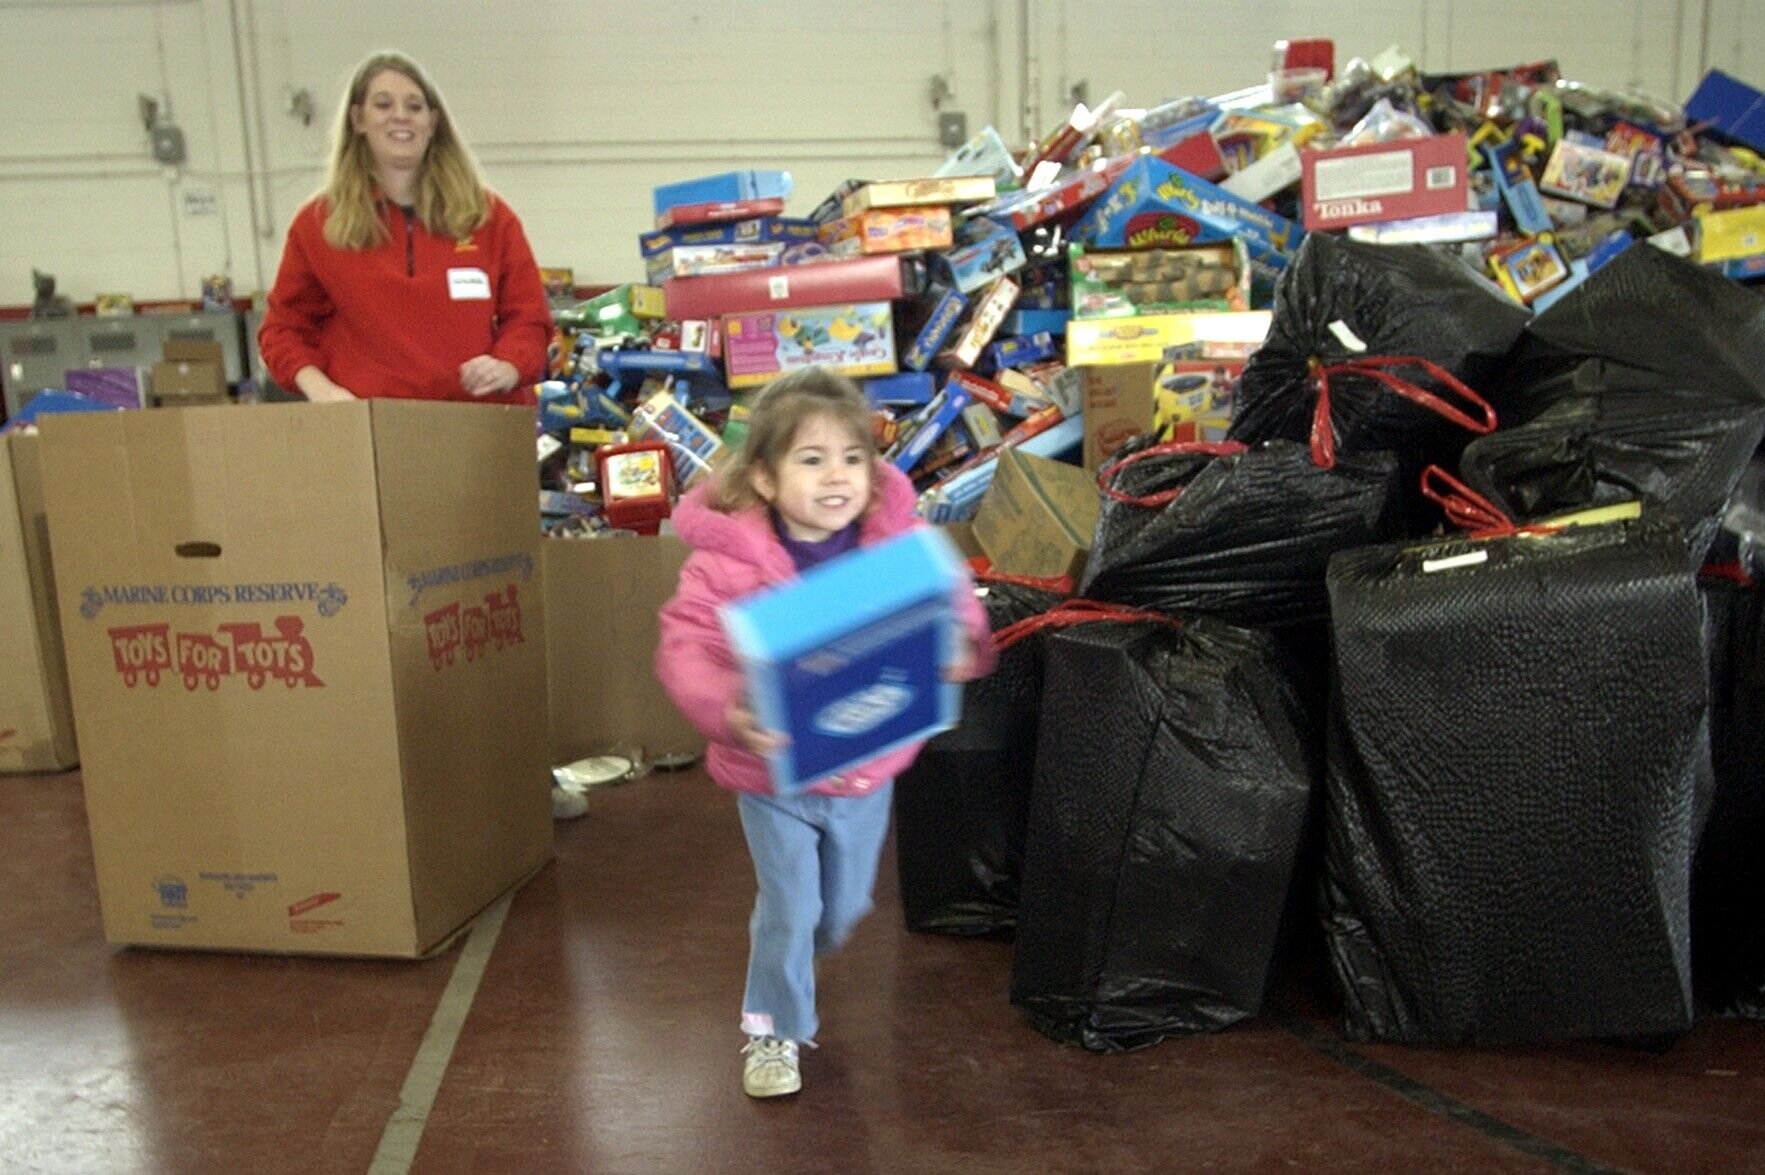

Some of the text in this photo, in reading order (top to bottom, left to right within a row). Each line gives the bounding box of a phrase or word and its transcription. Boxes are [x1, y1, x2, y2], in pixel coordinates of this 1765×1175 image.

[1313, 199, 1384, 221] Tonka
[103, 582, 319, 604] MARINE CORPS RESERVE
[114, 632, 305, 672] TOYS FOR TOTS
